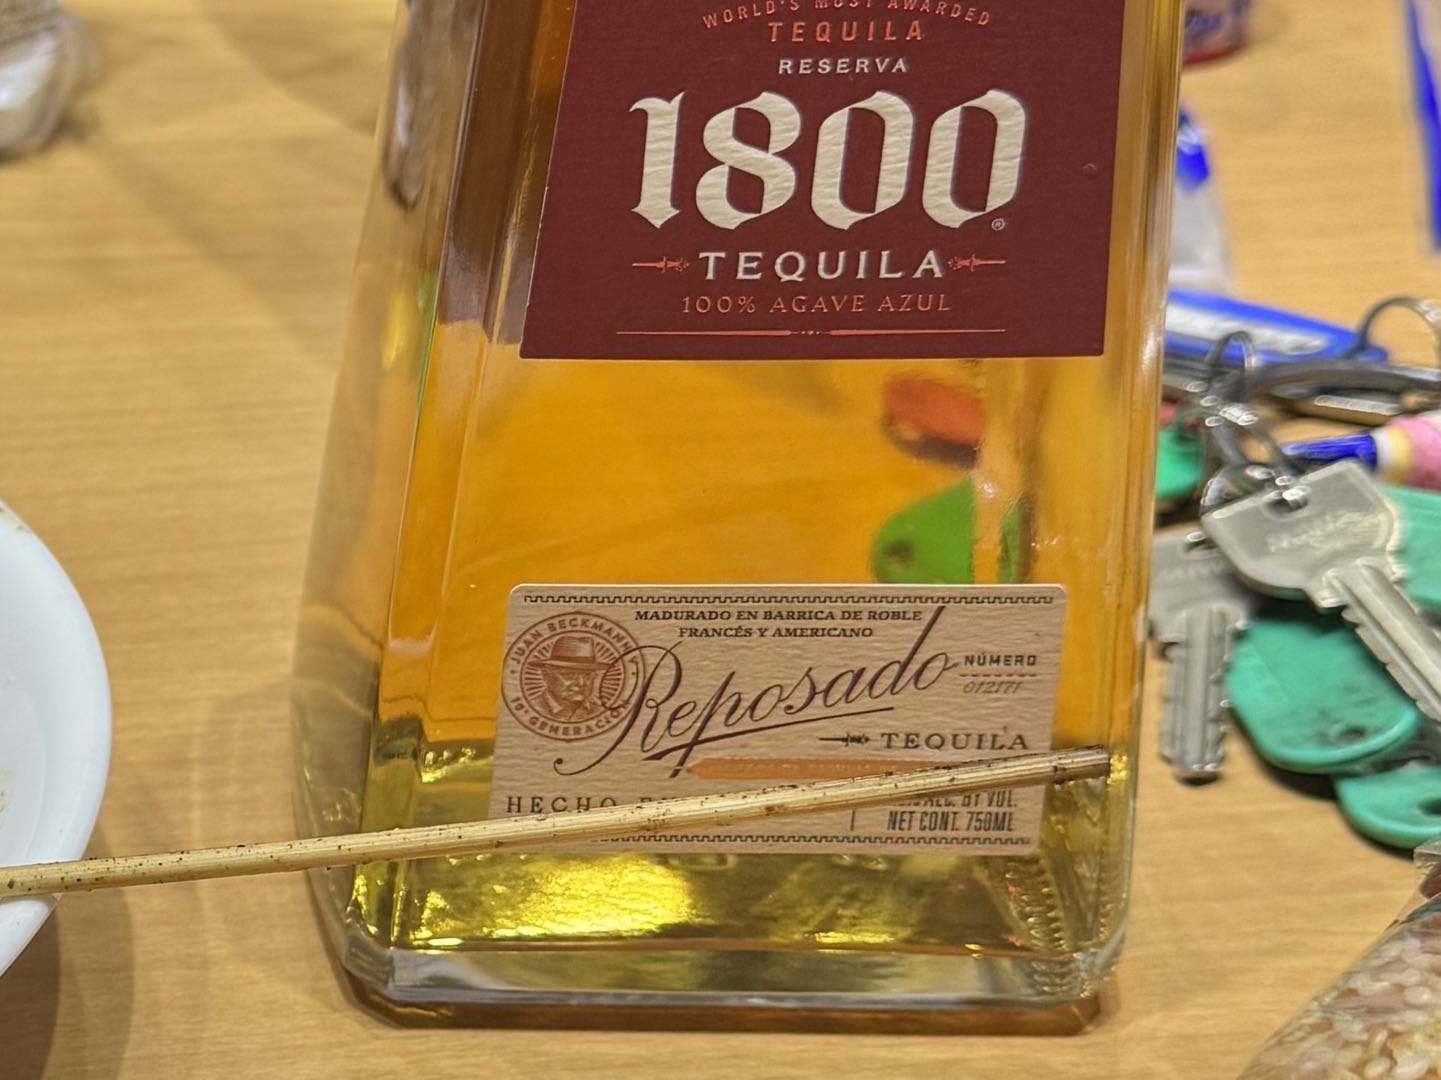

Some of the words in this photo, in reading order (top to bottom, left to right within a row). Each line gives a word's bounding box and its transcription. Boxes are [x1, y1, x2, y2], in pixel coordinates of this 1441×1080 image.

[767, 20, 924, 42] TEQUILA
[778, 58, 908, 74] RESERVA
[628, 88, 1029, 231] 1800
[698, 249, 945, 283] TEQUILA
[681, 295, 757, 313] 100%
[768, 294, 865, 313] AGAVE
[877, 293, 952, 312] AZUL
[635, 610, 731, 622] MADURADO
[737, 610, 758, 621] EN
[763, 610, 835, 621] BARRICA
[841, 610, 863, 621] DE
[867, 610, 922, 621] ROBLE
[510, 629, 543, 665] JUAN
[547, 617, 633, 656] BECKMANN
[678, 626, 752, 638] FRANCÉS
[757, 628, 769, 638] Y
[771, 627, 874, 638] AMERICANO
[964, 651, 1037, 667] NÚMERO
[553, 605, 961, 778] Reposado
[881, 733, 1029, 751] TEQUILA
[506, 796, 617, 814] HECHO
[887, 810, 914, 831] NET
[919, 810, 960, 832] CONT.
[965, 810, 1016, 832] 750ML
